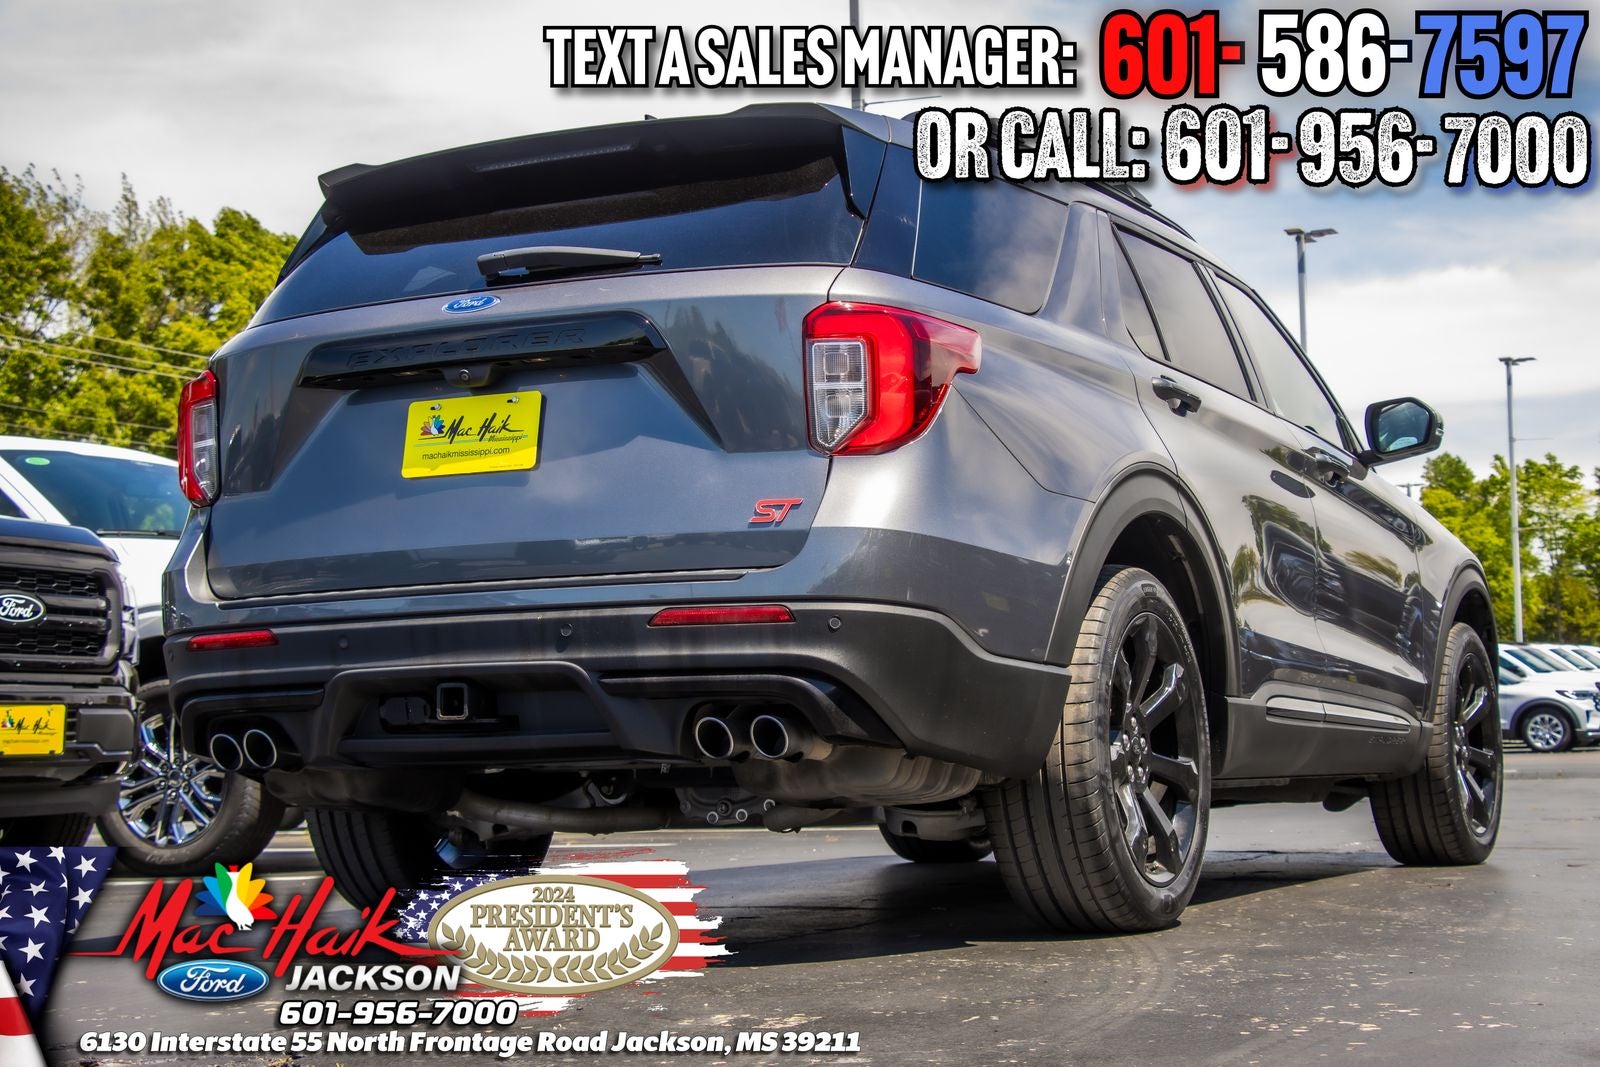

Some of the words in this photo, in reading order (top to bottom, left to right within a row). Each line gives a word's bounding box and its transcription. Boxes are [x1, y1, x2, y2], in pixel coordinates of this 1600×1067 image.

[346, 328, 586, 369] EXPLORER
[443, 415, 476, 445] Mac
[477, 412, 525, 442] Haik
[422, 446, 511, 461] machaikmississippi.com
[749, 497, 804, 524] ST
[0, 596, 34, 619] Ford
